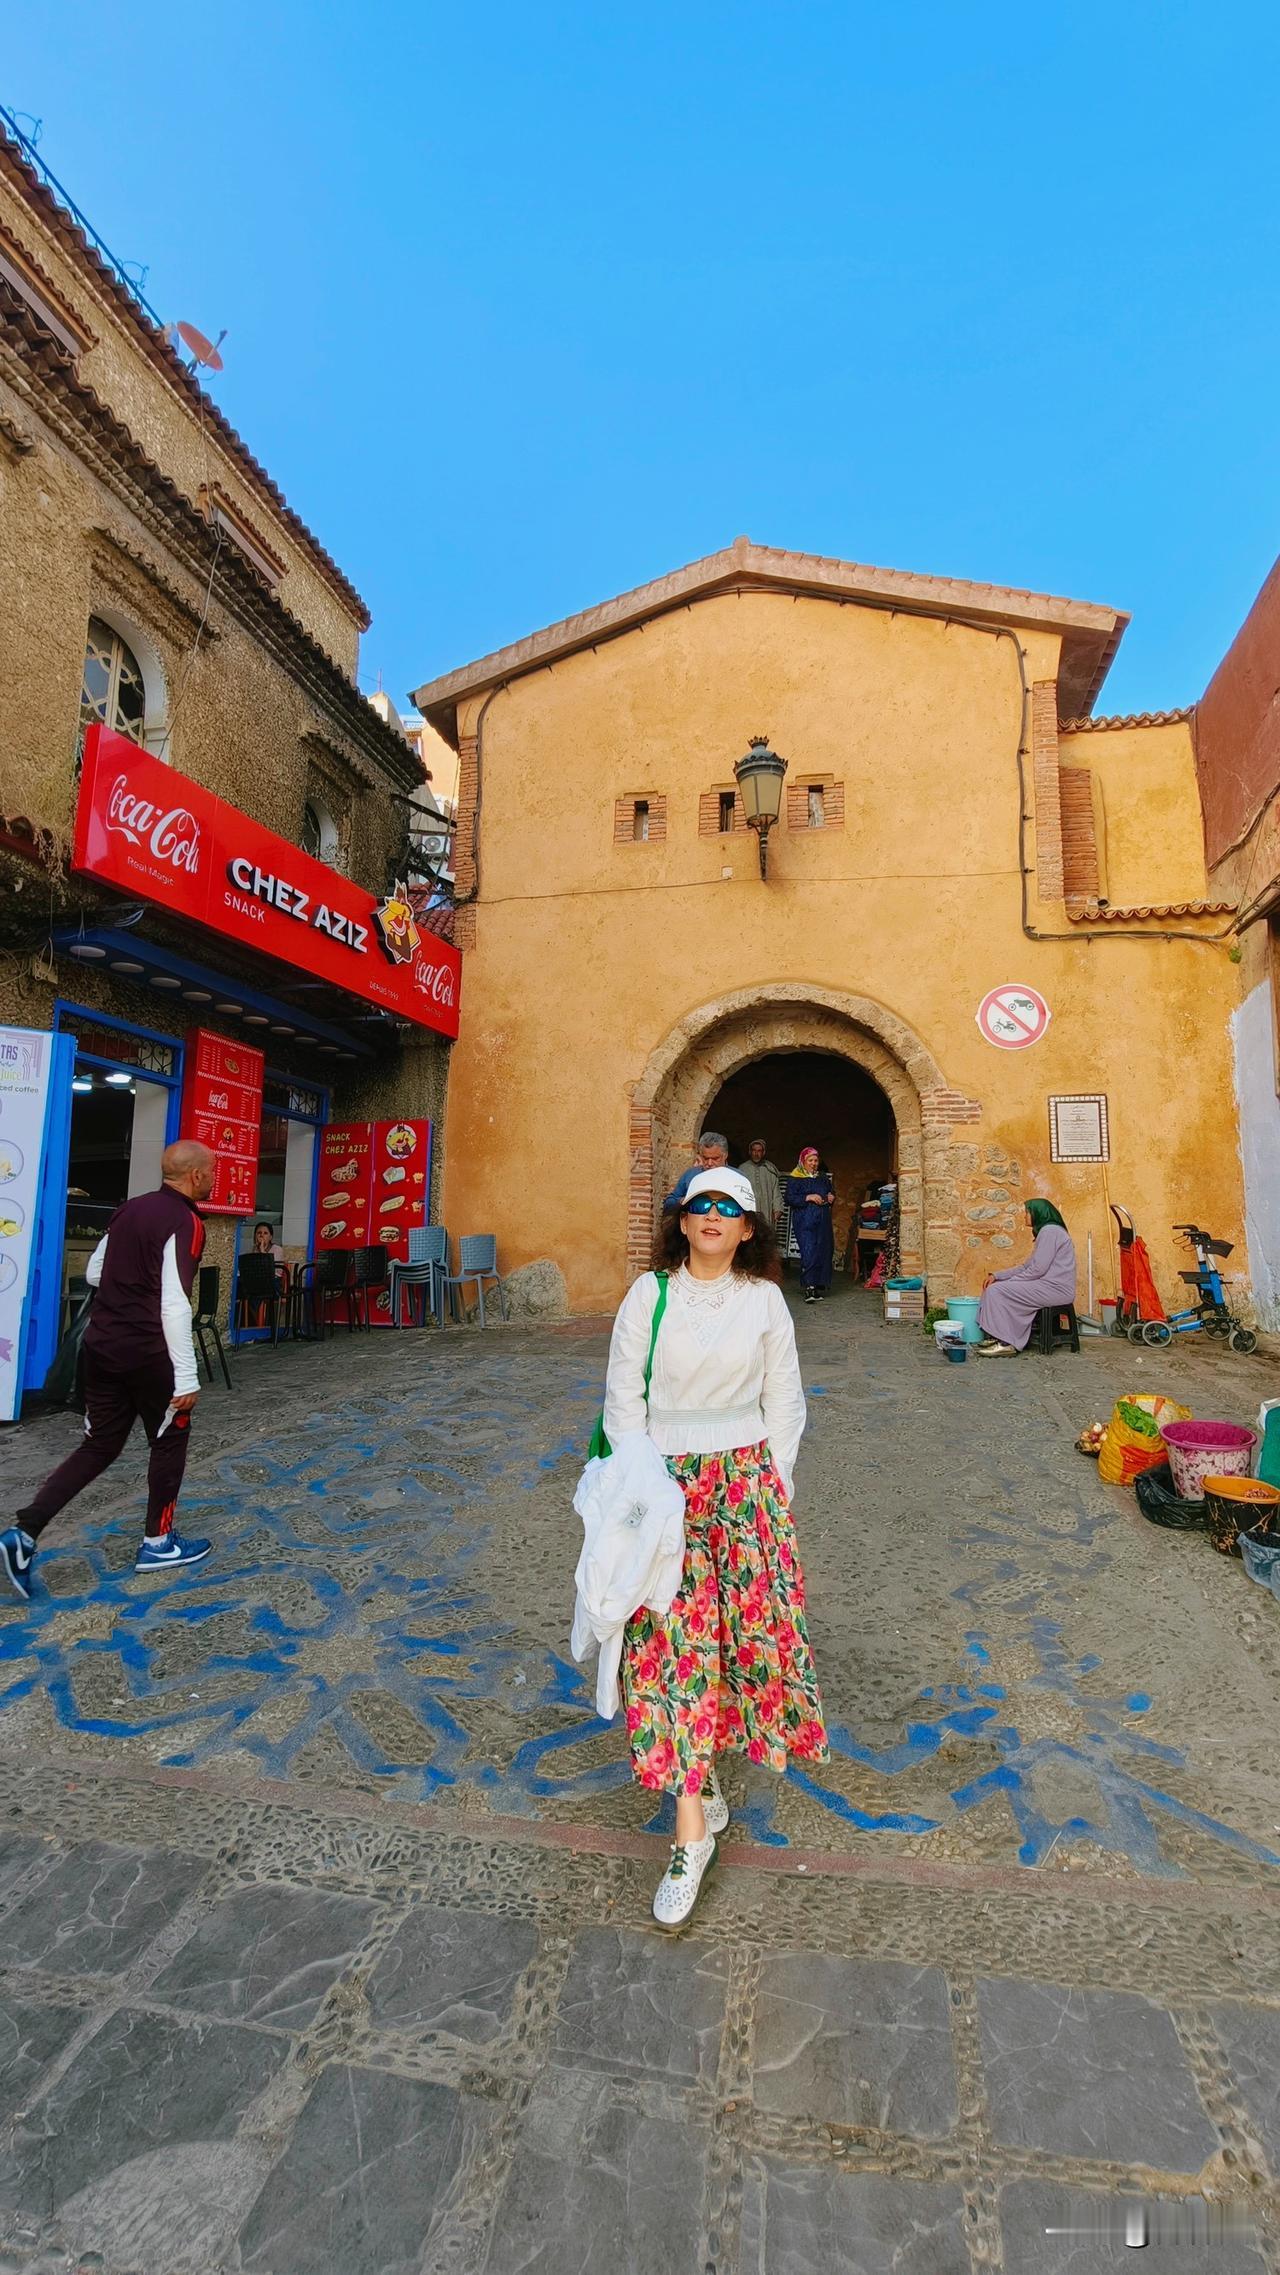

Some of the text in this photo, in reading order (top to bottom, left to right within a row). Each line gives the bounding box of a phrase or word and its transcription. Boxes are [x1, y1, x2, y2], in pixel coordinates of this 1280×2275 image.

[223, 891, 266, 924] SNACK
[229, 857, 369, 954] CHEZ AZIZ
[326, 1132, 351, 1143] SNACK
[325, 1144, 369, 1155] CHEZ AZIZ
